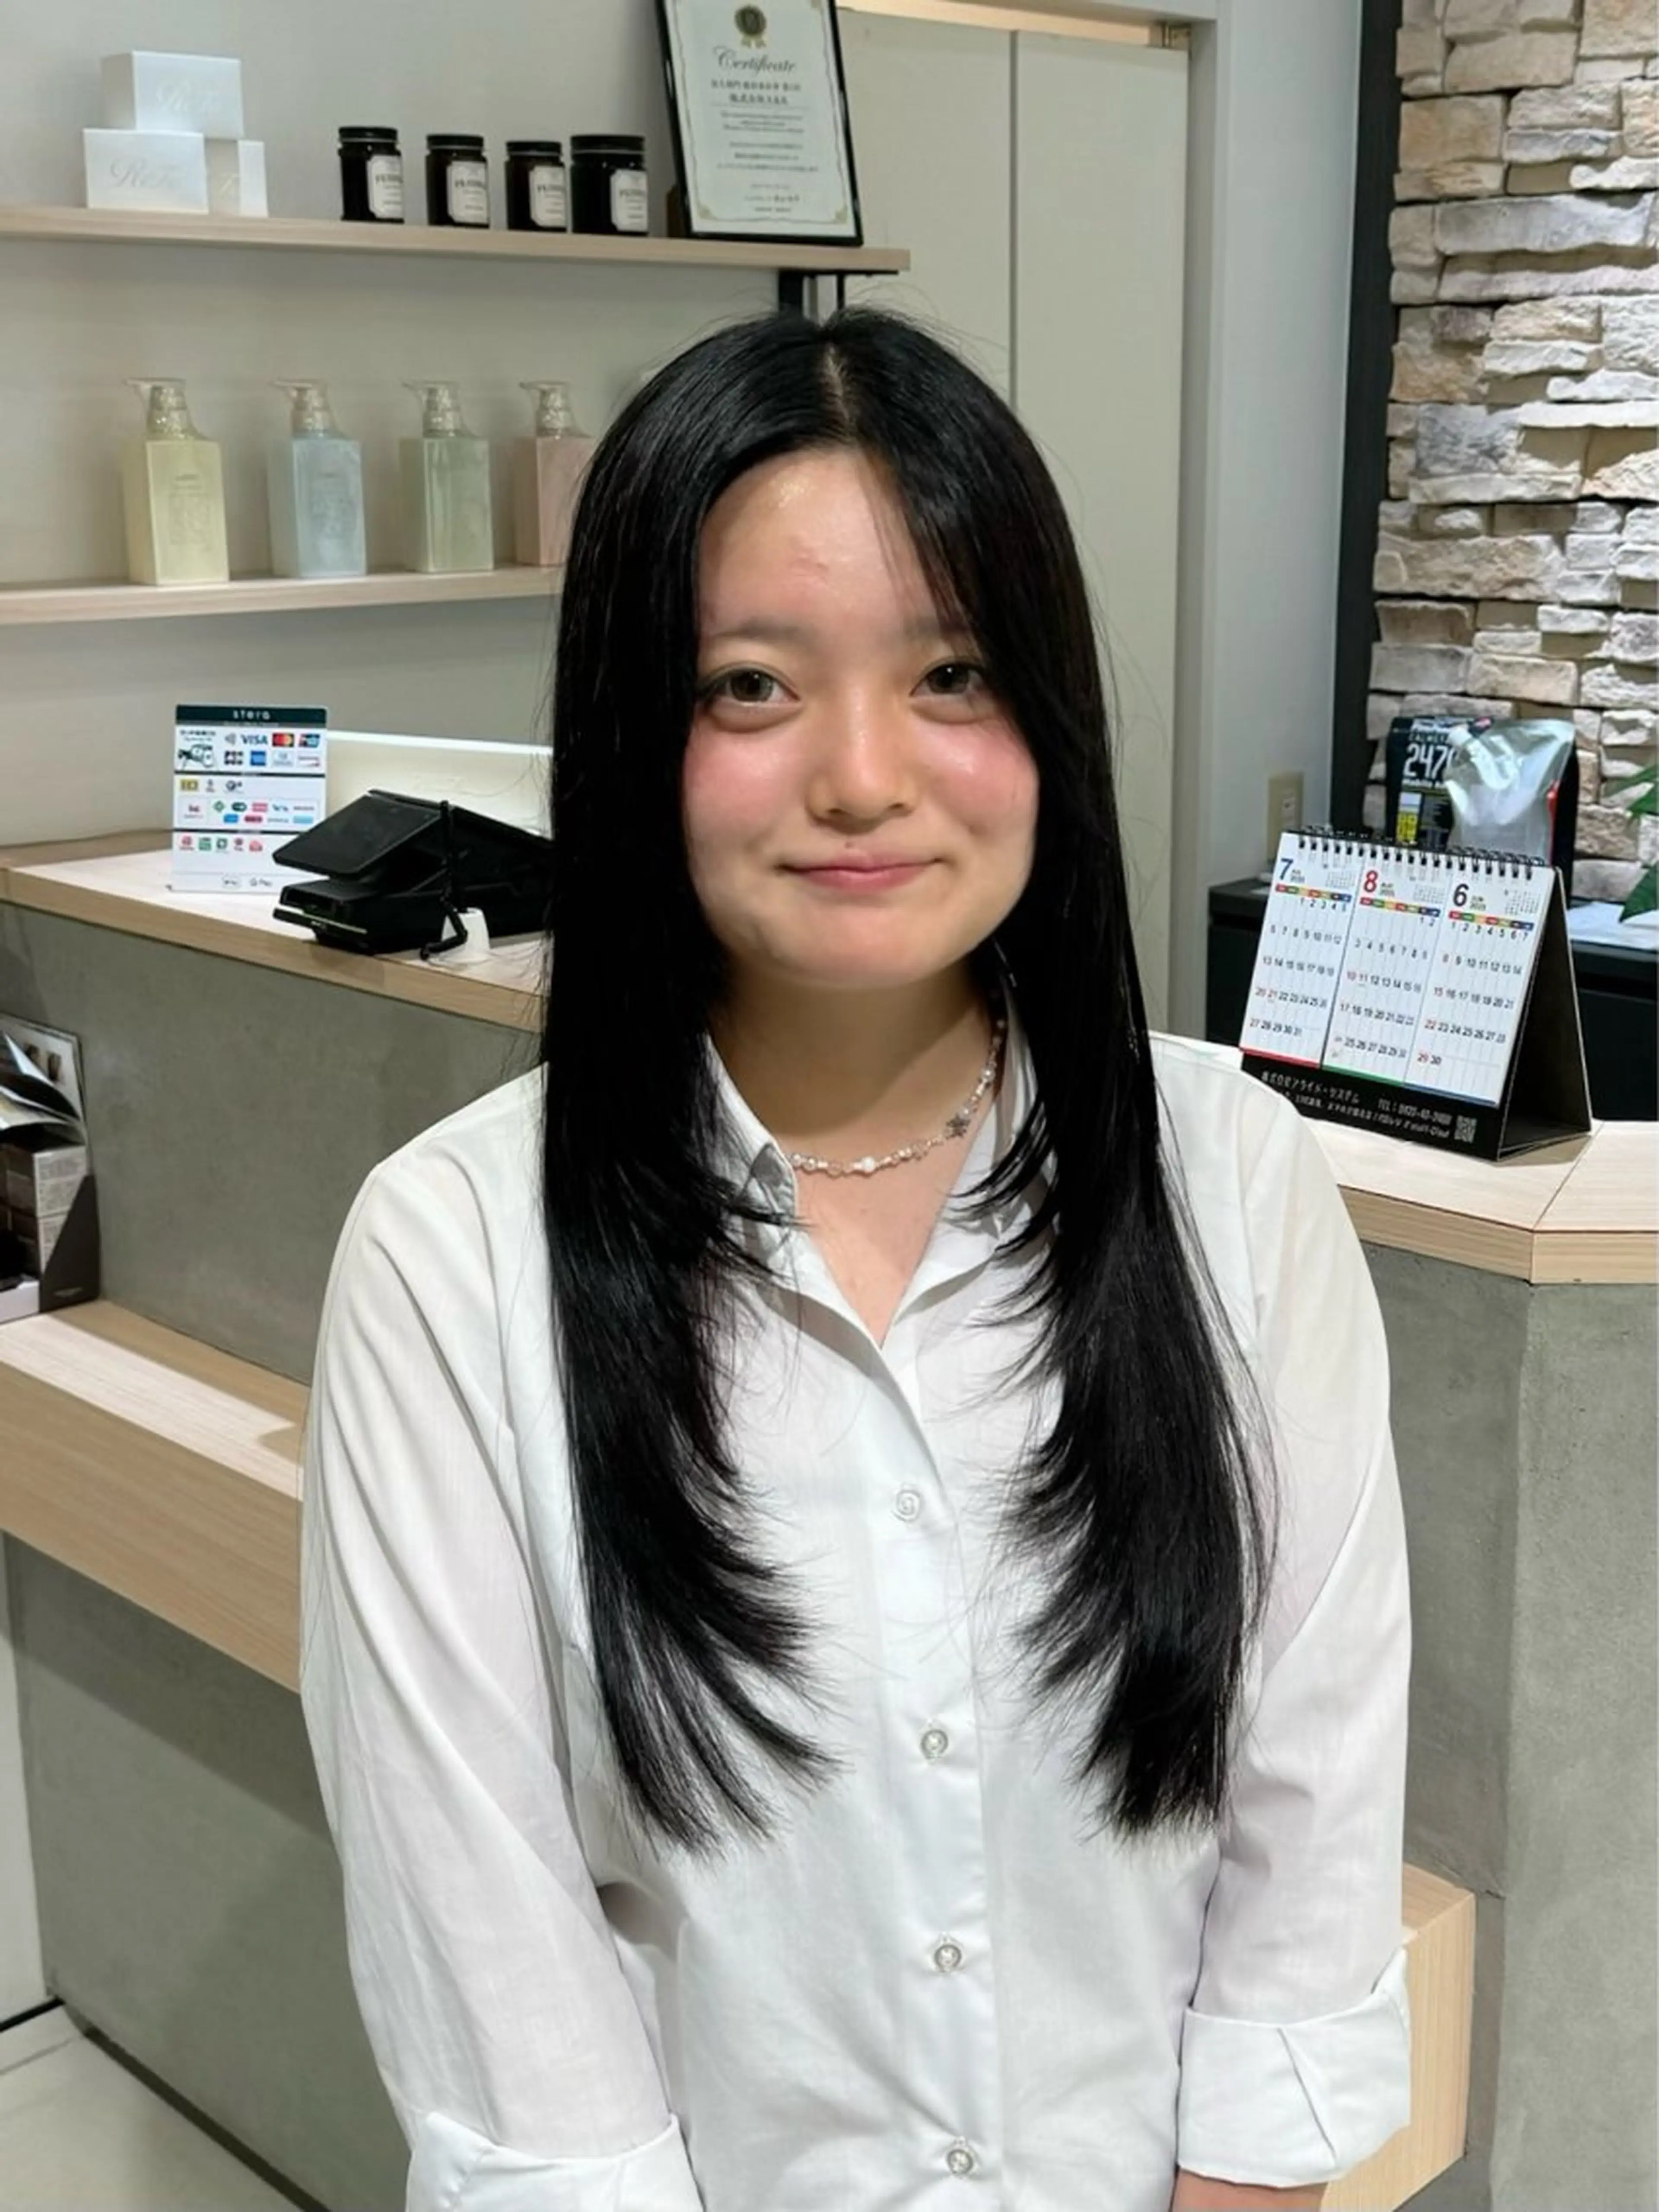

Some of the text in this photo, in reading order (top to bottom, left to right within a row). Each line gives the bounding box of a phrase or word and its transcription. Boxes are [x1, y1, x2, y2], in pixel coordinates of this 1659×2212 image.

[713, 45, 796, 75] Certificate
[241, 734, 269, 745] VISA
[1281, 858, 1294, 880] 7
[1363, 870, 1378, 893] 8
[1453, 884, 1469, 906] 6
